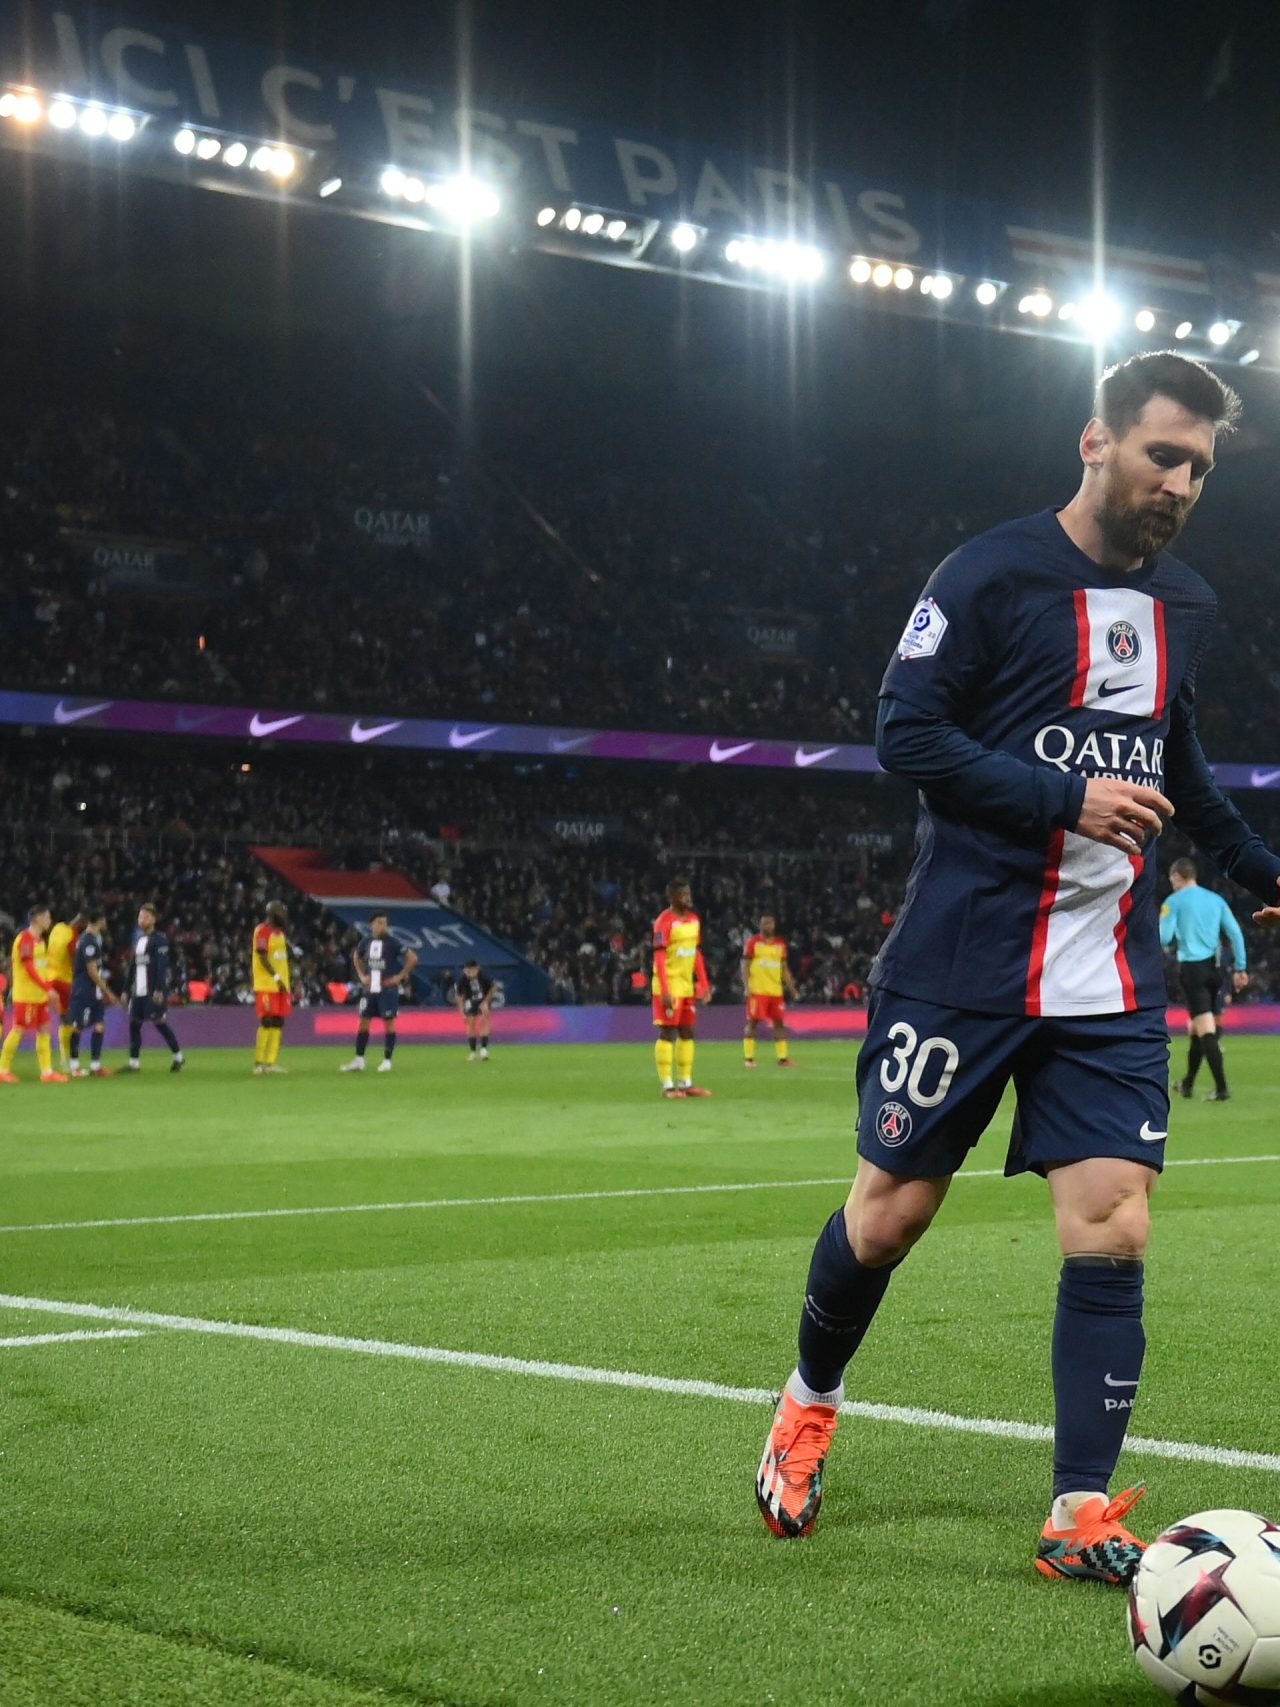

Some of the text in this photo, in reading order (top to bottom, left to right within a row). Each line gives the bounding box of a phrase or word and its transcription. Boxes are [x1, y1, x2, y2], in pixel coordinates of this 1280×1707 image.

[52, 12, 220, 118] ICI
[613, 136, 921, 256] PARIS
[354, 507, 431, 535] QATAR
[1034, 725, 1164, 775] QATAR
[880, 1021, 959, 1108] 30
[884, 1103, 908, 1121] PARIS
